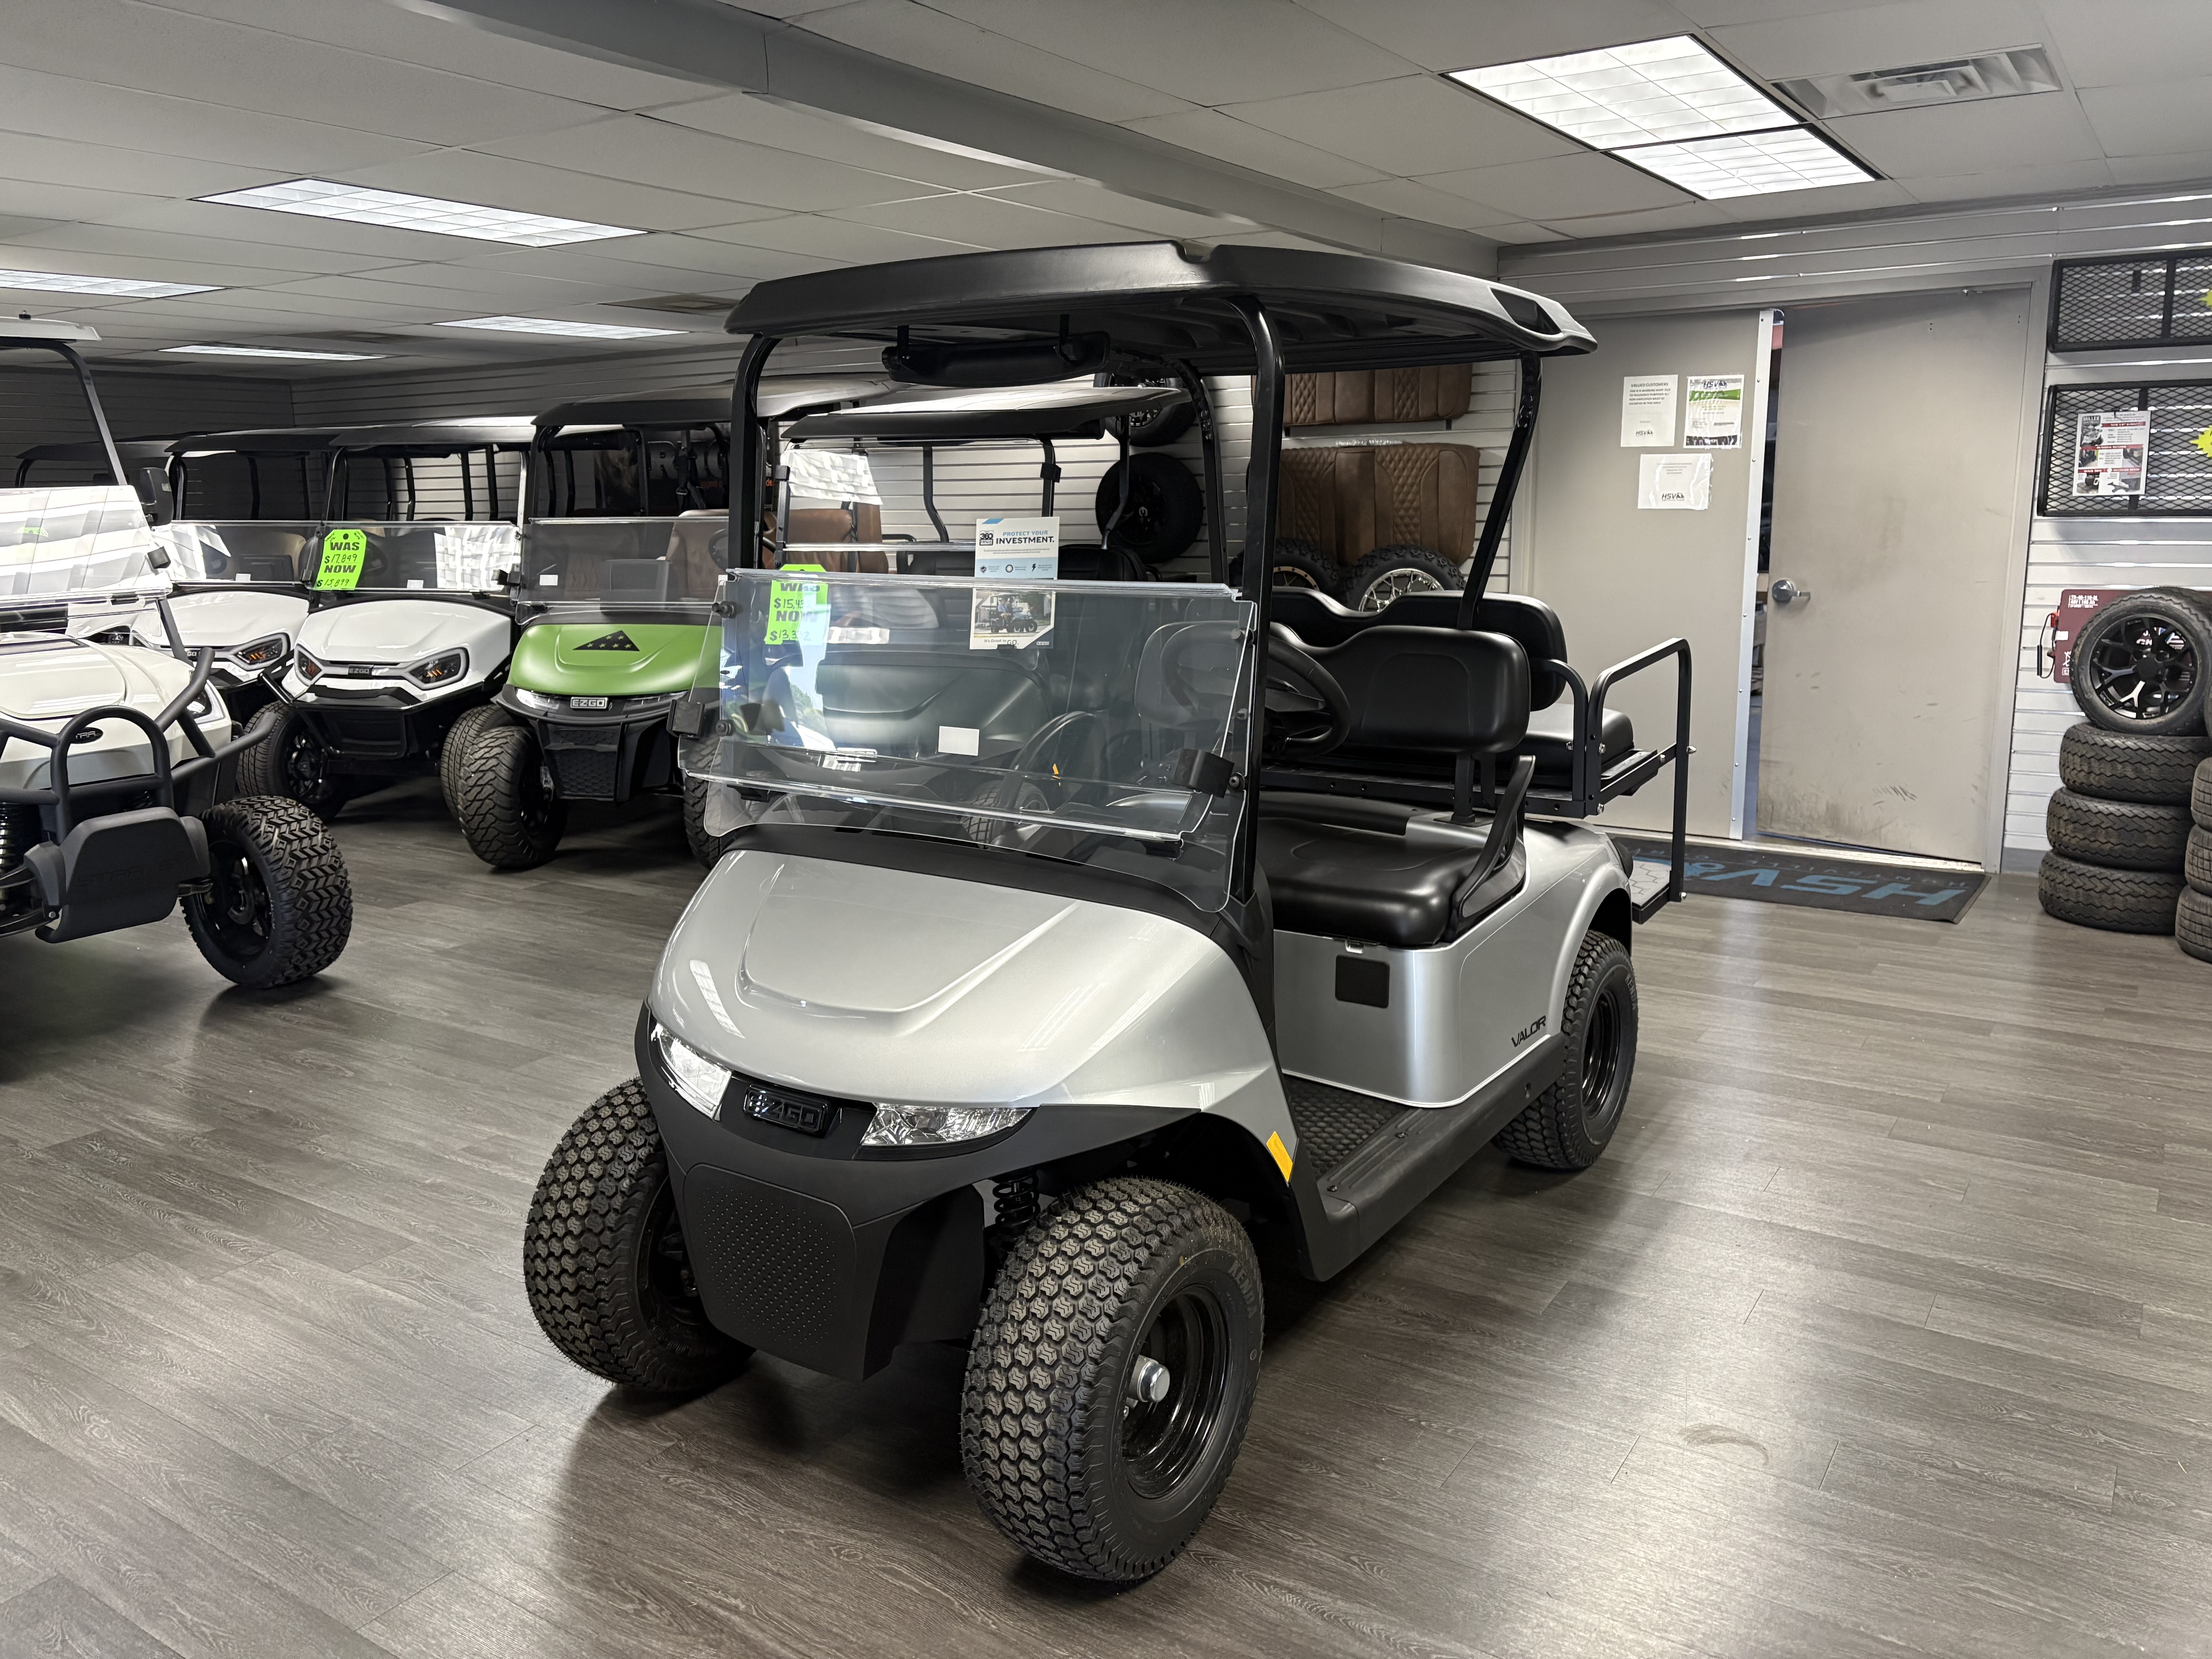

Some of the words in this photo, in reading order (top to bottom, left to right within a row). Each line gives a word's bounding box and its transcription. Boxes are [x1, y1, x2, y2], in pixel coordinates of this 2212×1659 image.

[330, 542, 360, 550] WAS
[1701, 868, 1967, 905] HSV
[1511, 1015, 1546, 1048] VALOR
[1227, 1259, 1257, 1319] KENDA
